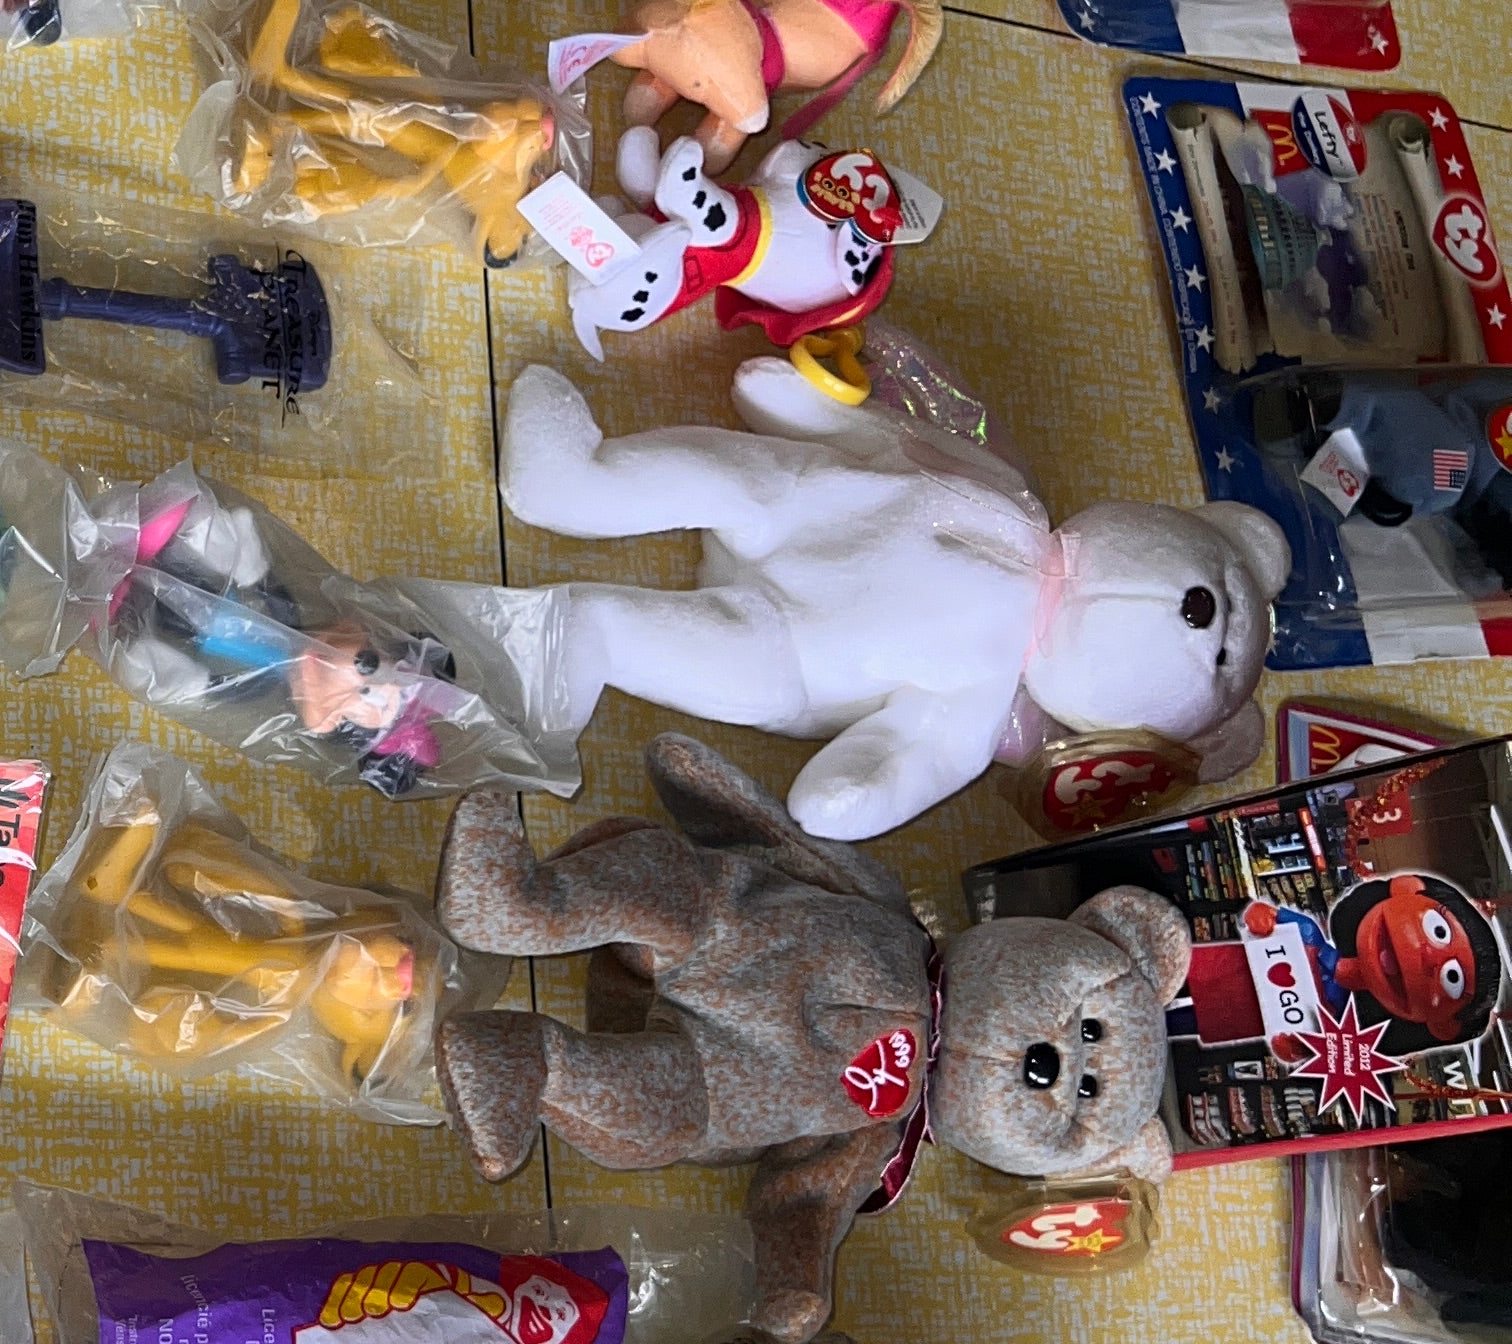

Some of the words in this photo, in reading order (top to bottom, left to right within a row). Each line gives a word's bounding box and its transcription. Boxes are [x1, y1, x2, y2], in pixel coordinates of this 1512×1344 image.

[1314, 111, 1343, 158] Lefty
[17, 200, 36, 244] Jim
[1444, 205, 1483, 274] ty
[19, 254, 40, 361] Hawkins
[282, 250, 307, 415] TREASURE
[1265, 945, 1286, 959] I
[1279, 990, 1304, 1024] GO
[1326, 1032, 1337, 1073] Edition
[1342, 1033, 1356, 1076] Limited
[1359, 1043, 1371, 1071] 2012
